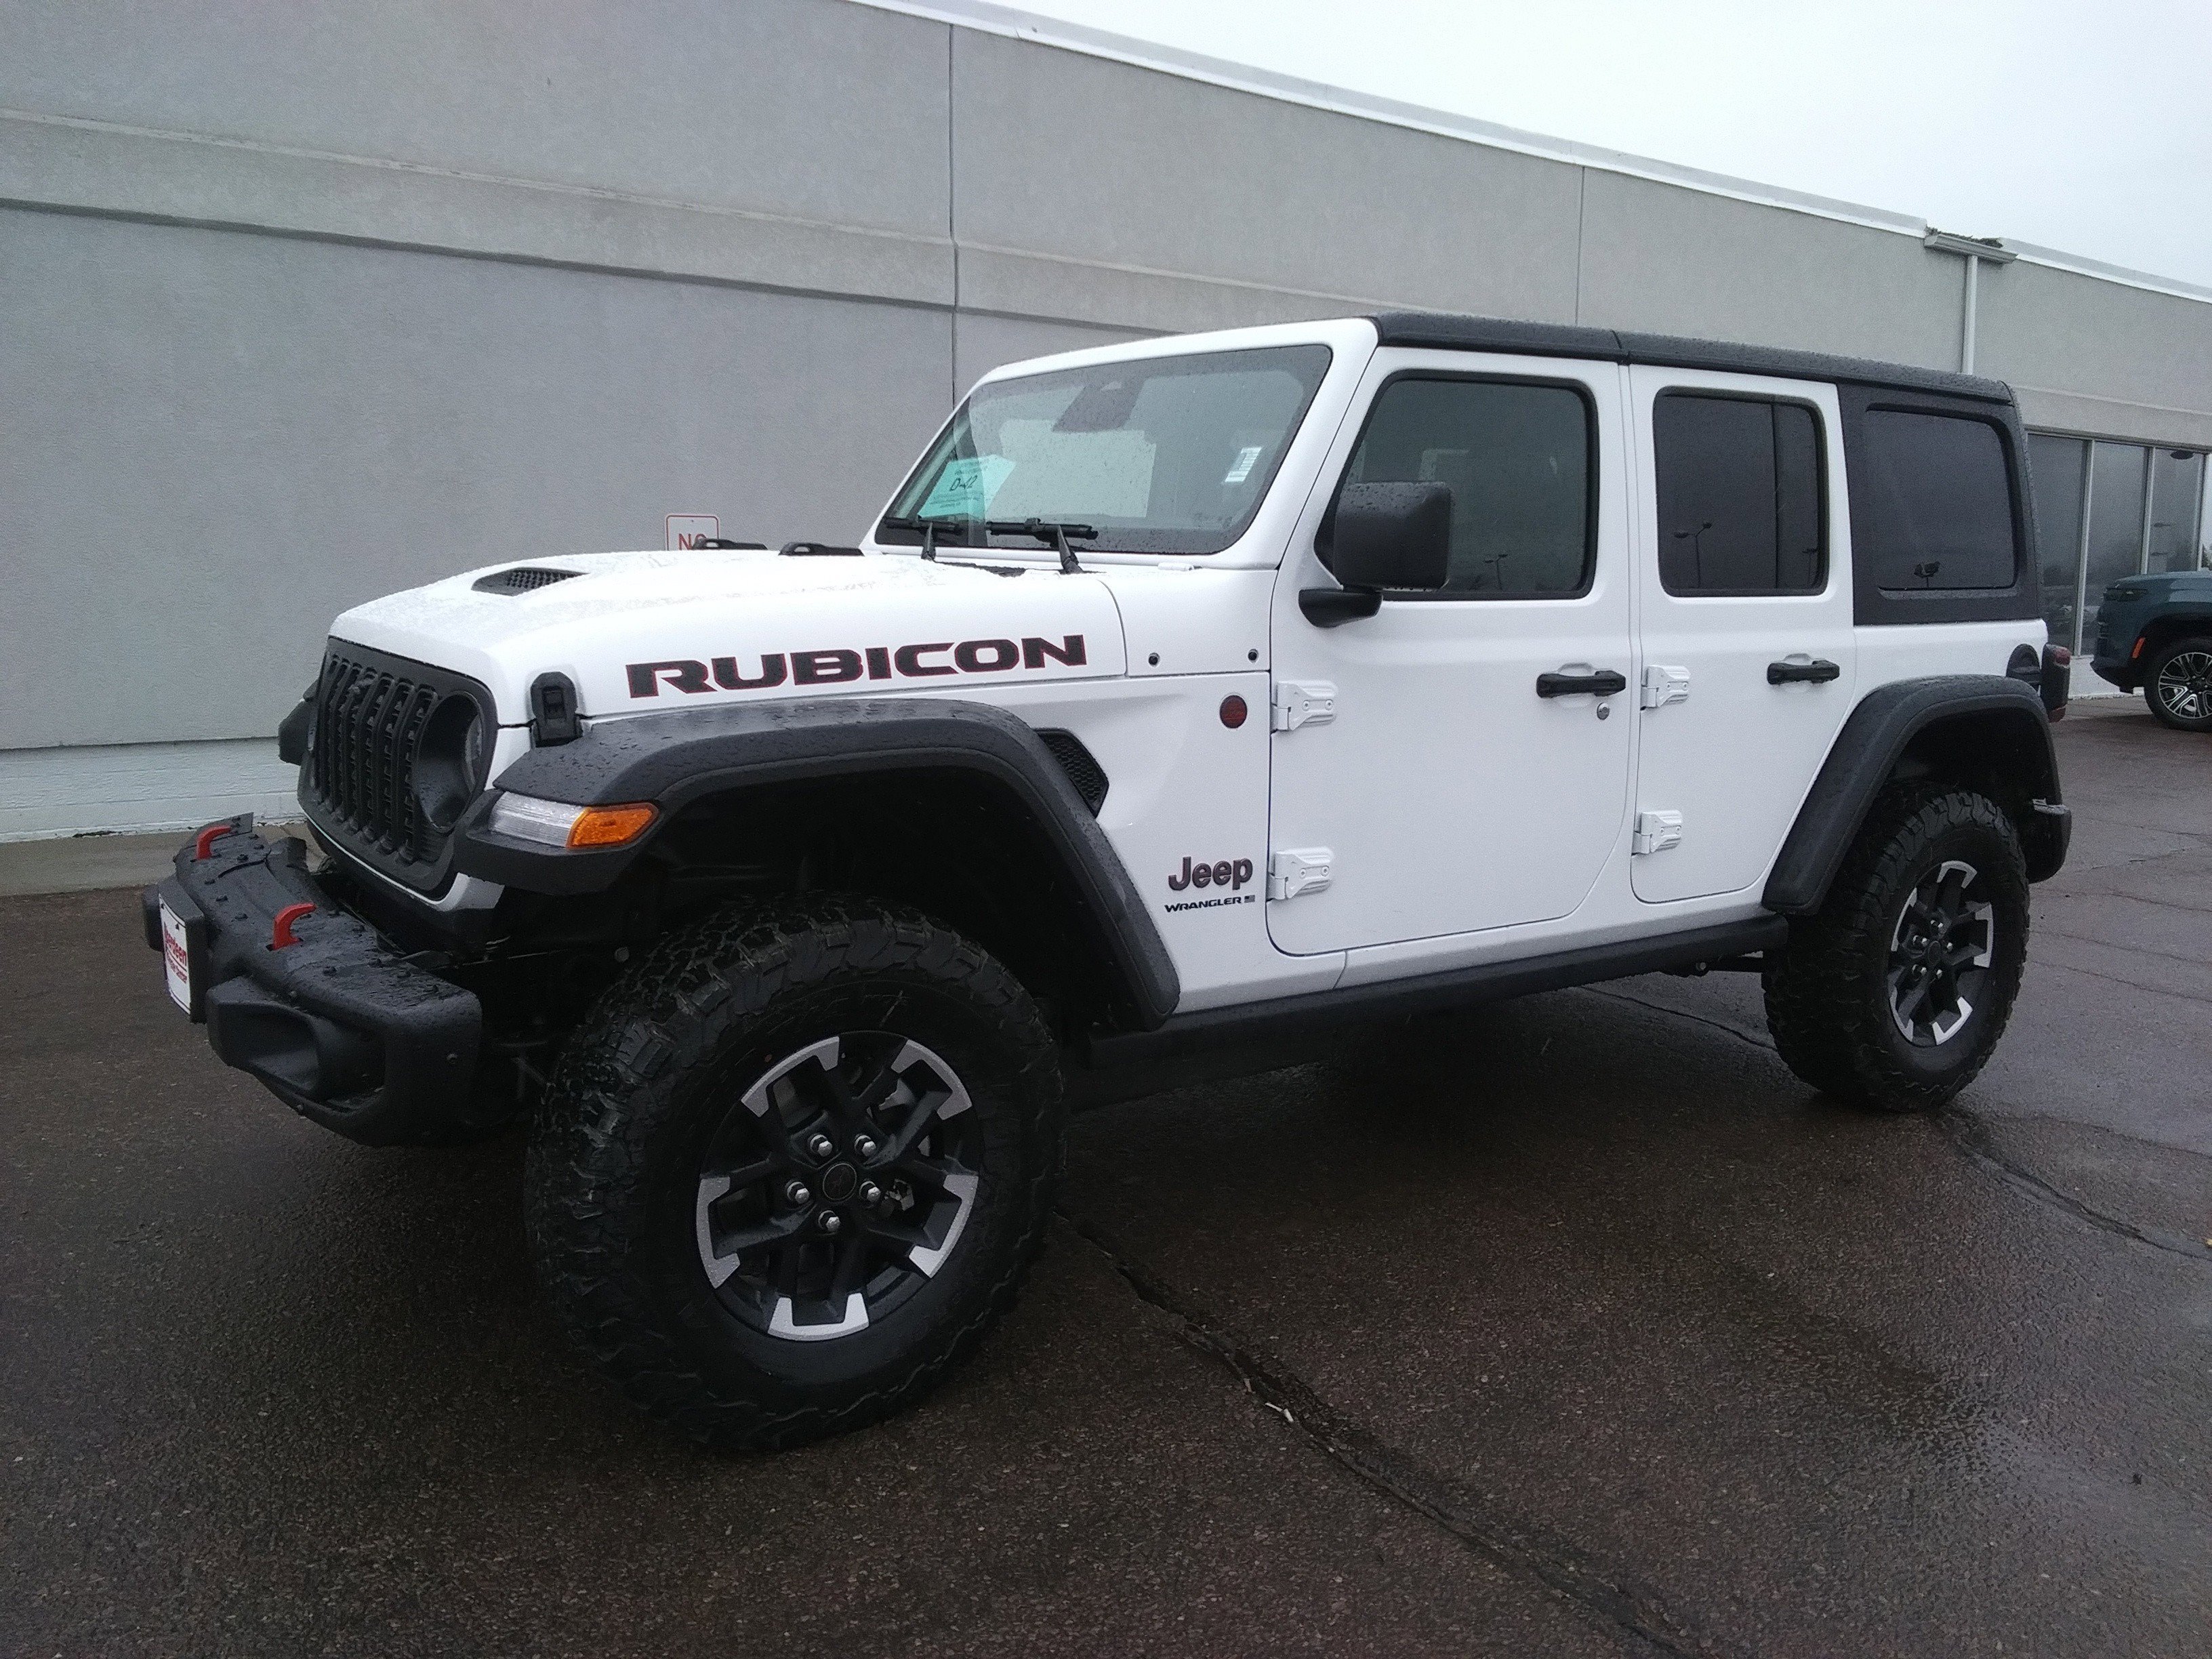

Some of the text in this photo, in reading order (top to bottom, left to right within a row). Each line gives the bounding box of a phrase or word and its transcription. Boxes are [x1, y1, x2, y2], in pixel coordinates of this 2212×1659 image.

[626, 634, 1087, 699] RUBICON
[1168, 856, 1253, 891] Jeep
[1164, 897, 1242, 913] WRANGLER
